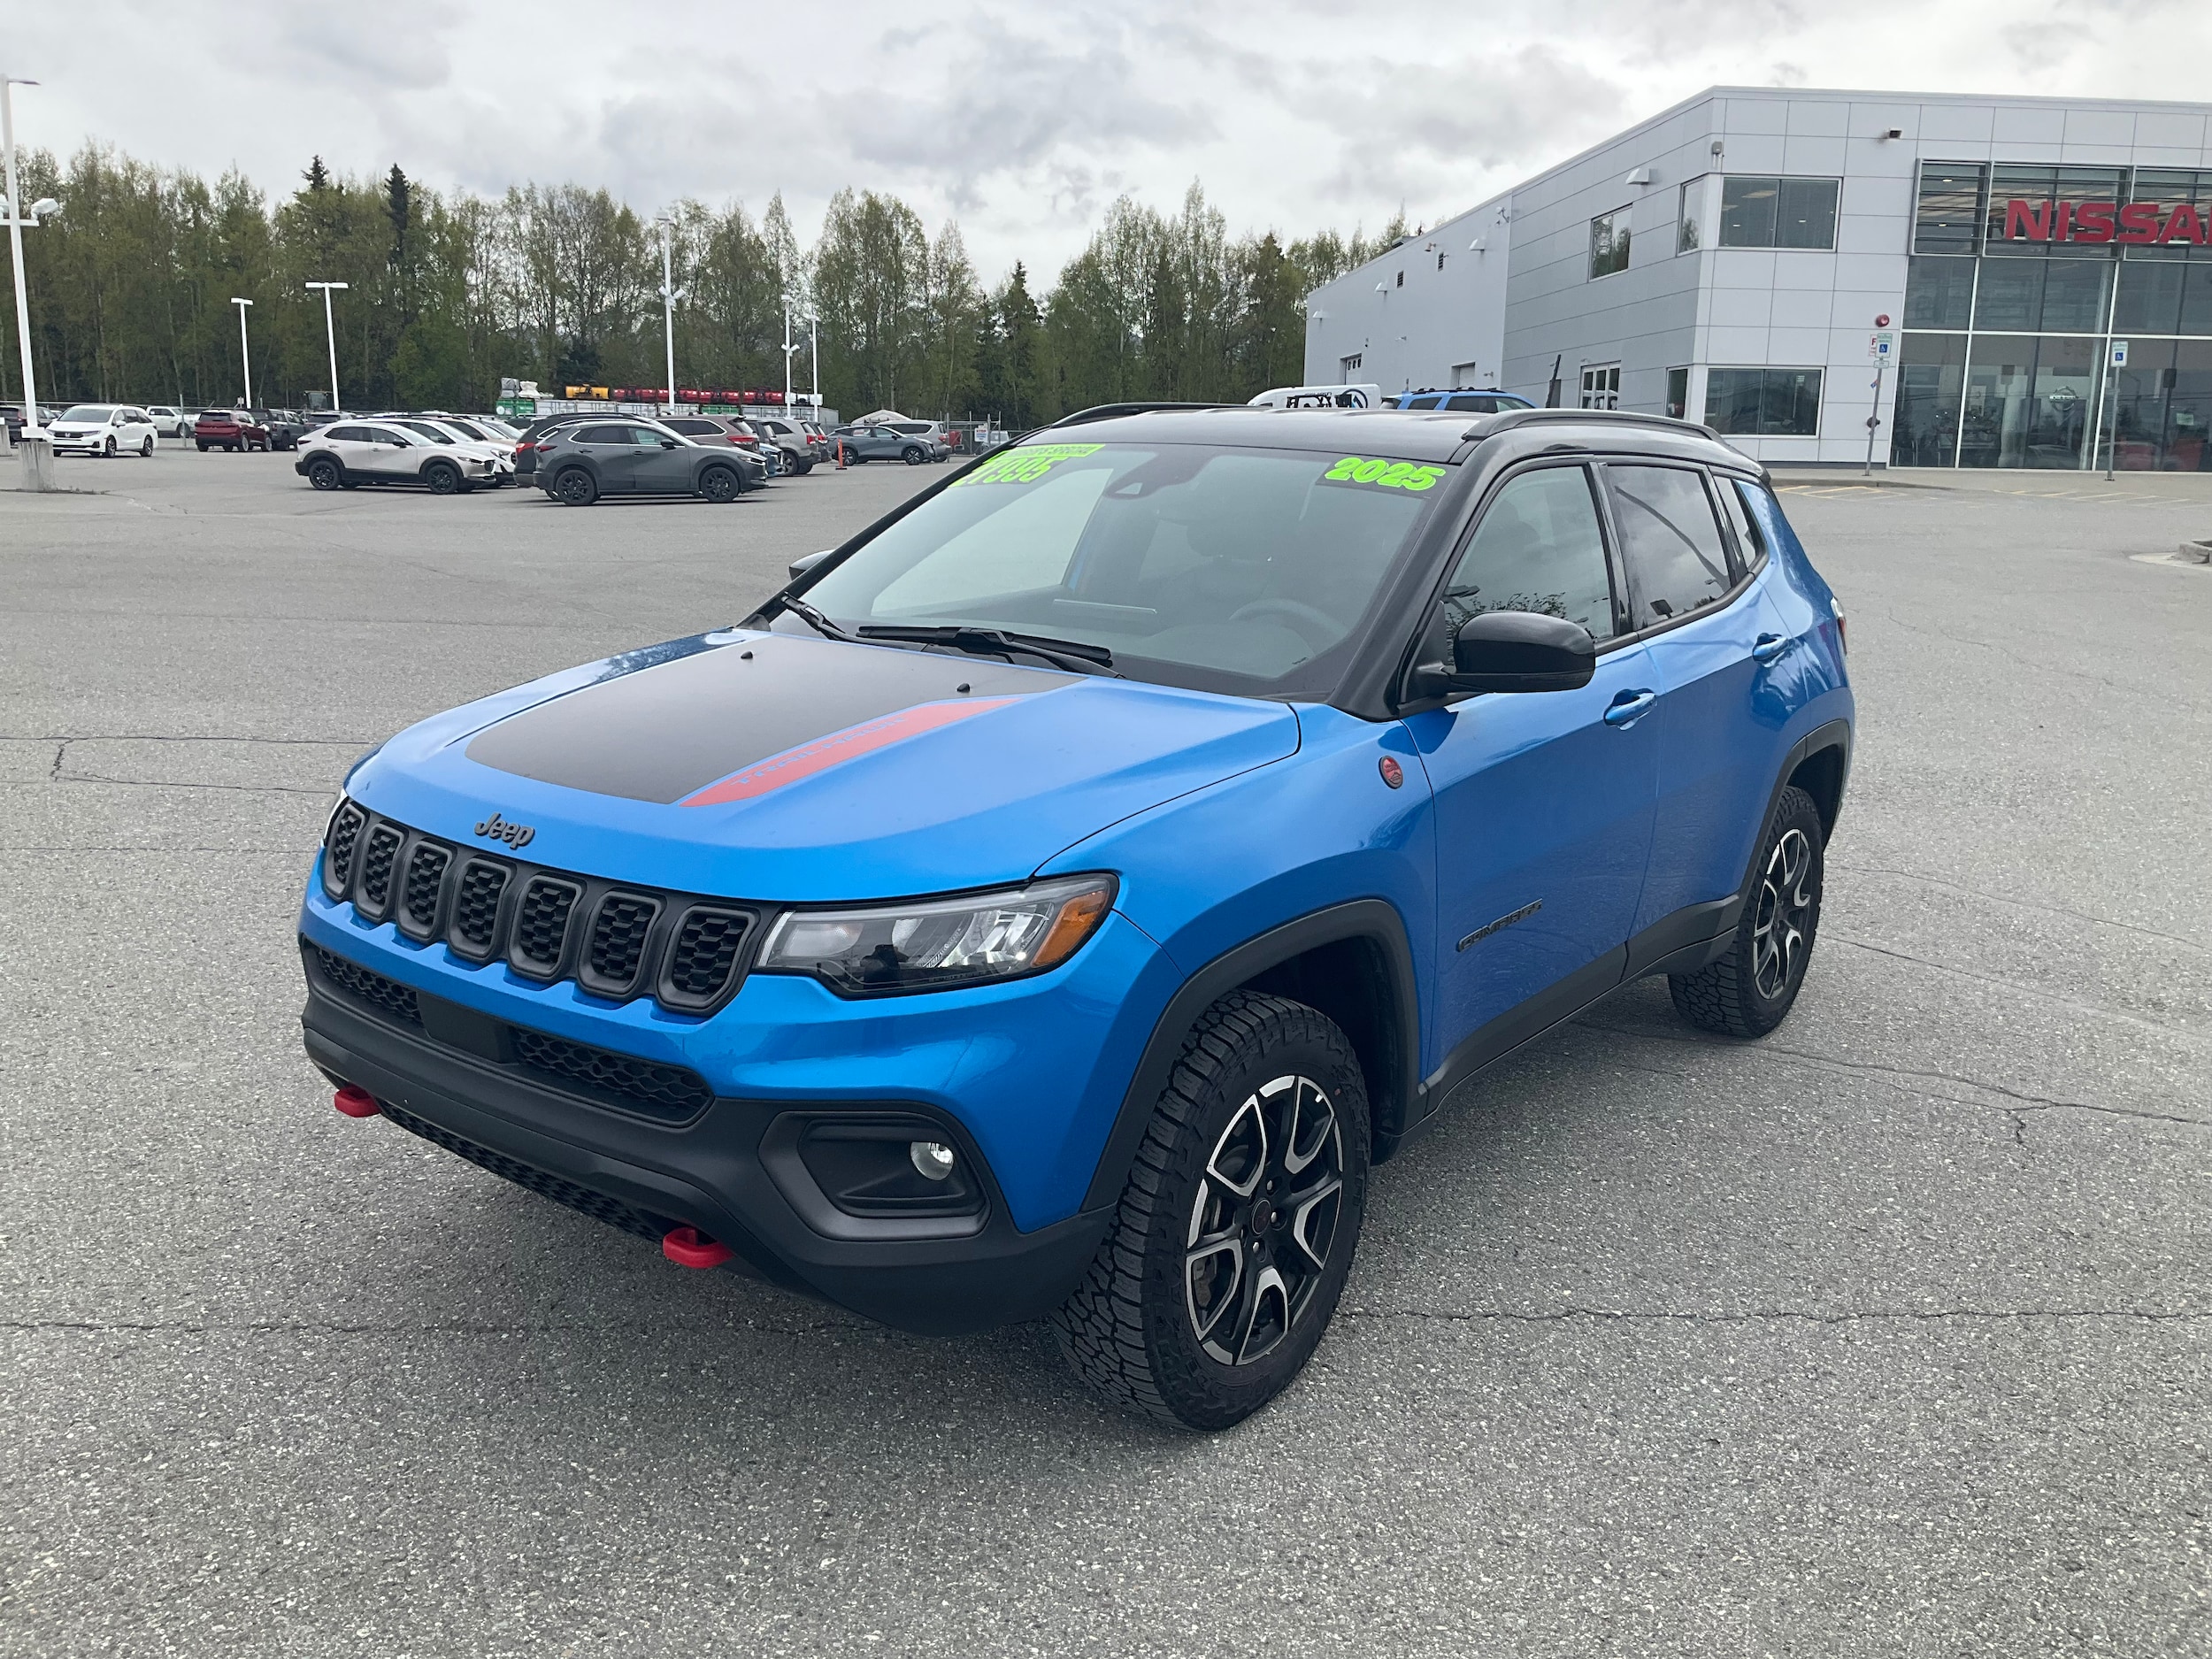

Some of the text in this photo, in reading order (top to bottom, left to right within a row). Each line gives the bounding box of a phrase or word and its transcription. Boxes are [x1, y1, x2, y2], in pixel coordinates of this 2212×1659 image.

[2005, 200, 2212, 244] NISSA
[1325, 457, 1446, 491] 2025
[474, 812, 535, 850] Jeep
